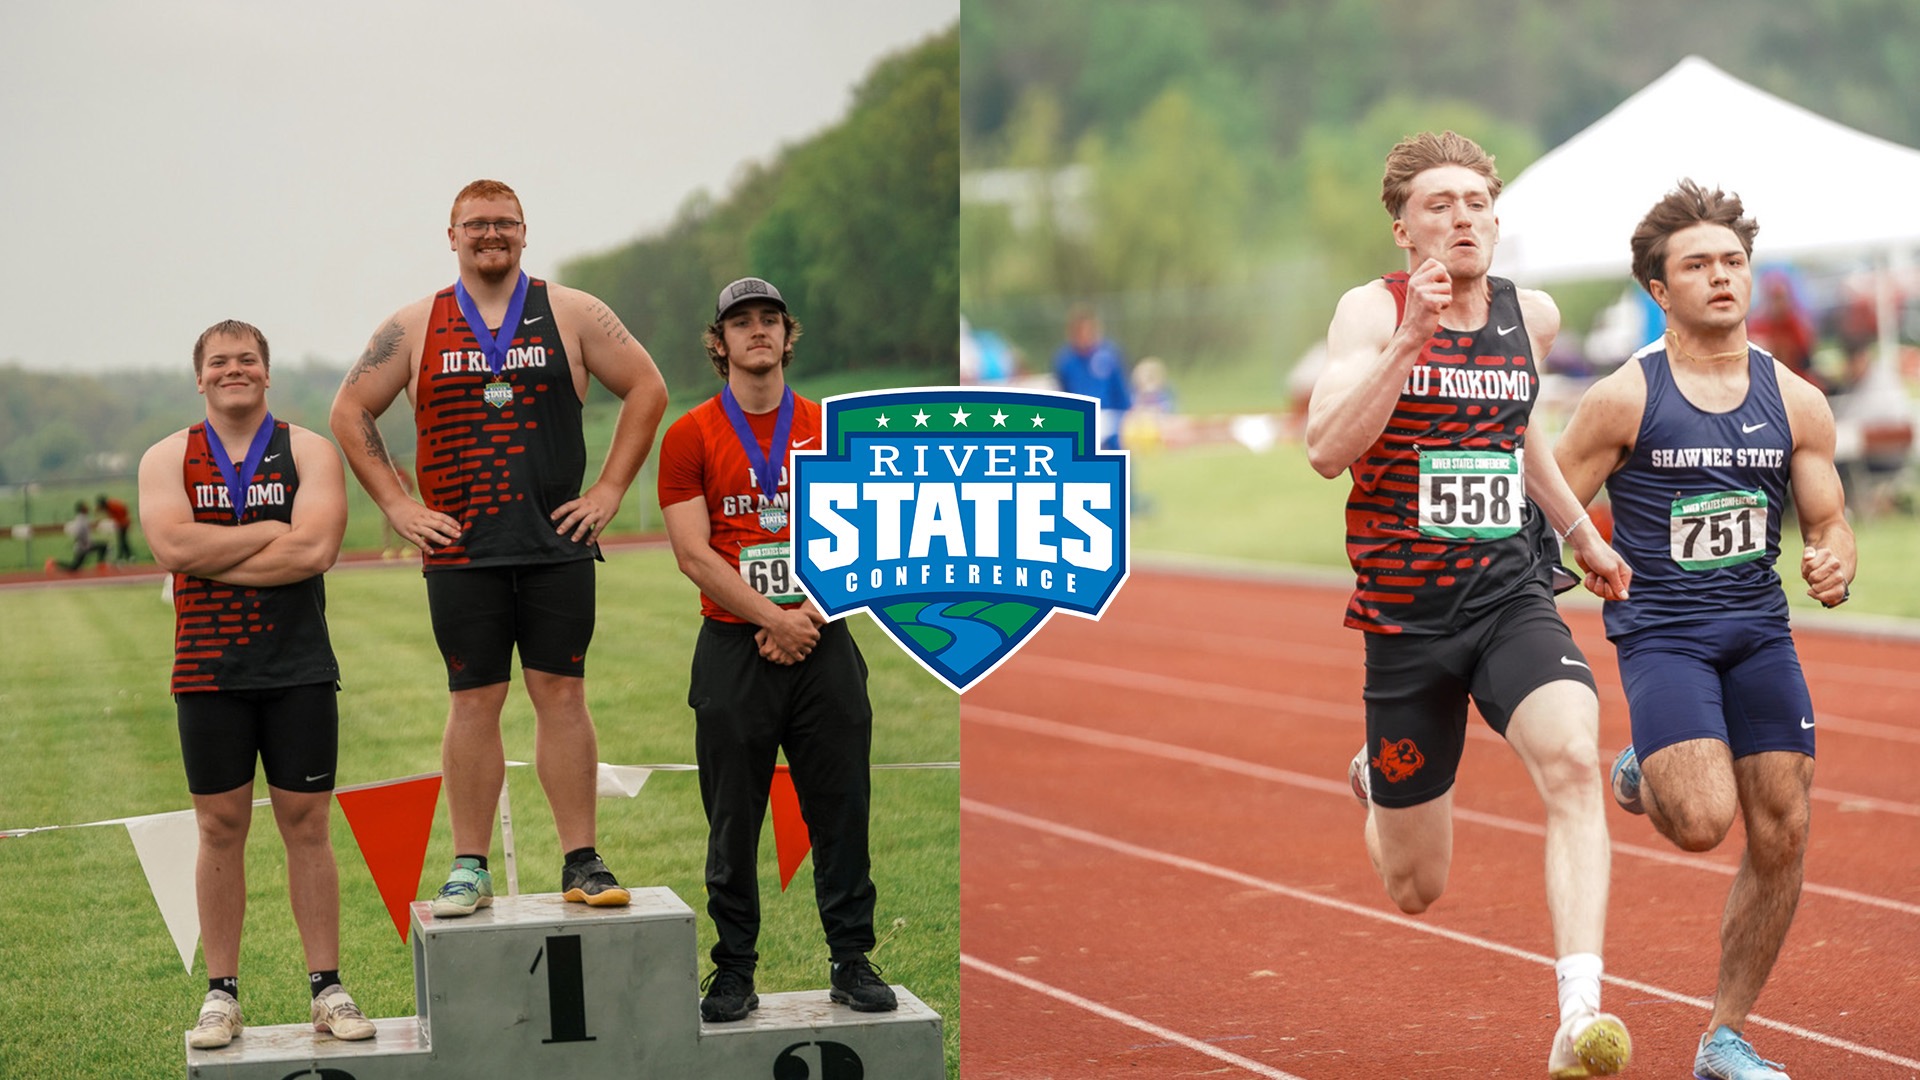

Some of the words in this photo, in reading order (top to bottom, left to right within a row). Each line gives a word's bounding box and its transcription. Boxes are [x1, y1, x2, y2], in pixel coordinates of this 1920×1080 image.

[442, 351, 463, 374] IU
[467, 346, 546, 373] KOOMO
[1438, 367, 1531, 402] KOKOMO
[1651, 448, 1733, 468] SHAWNEE
[1736, 448, 1784, 468] STATE
[195, 484, 214, 509] IU
[217, 482, 285, 509] KOMO
[722, 491, 790, 517] GRAN
[1430, 475, 1511, 525] 558
[1681, 509, 1756, 559] 751
[749, 559, 805, 595] 69
[529, 934, 598, 1044] 1
